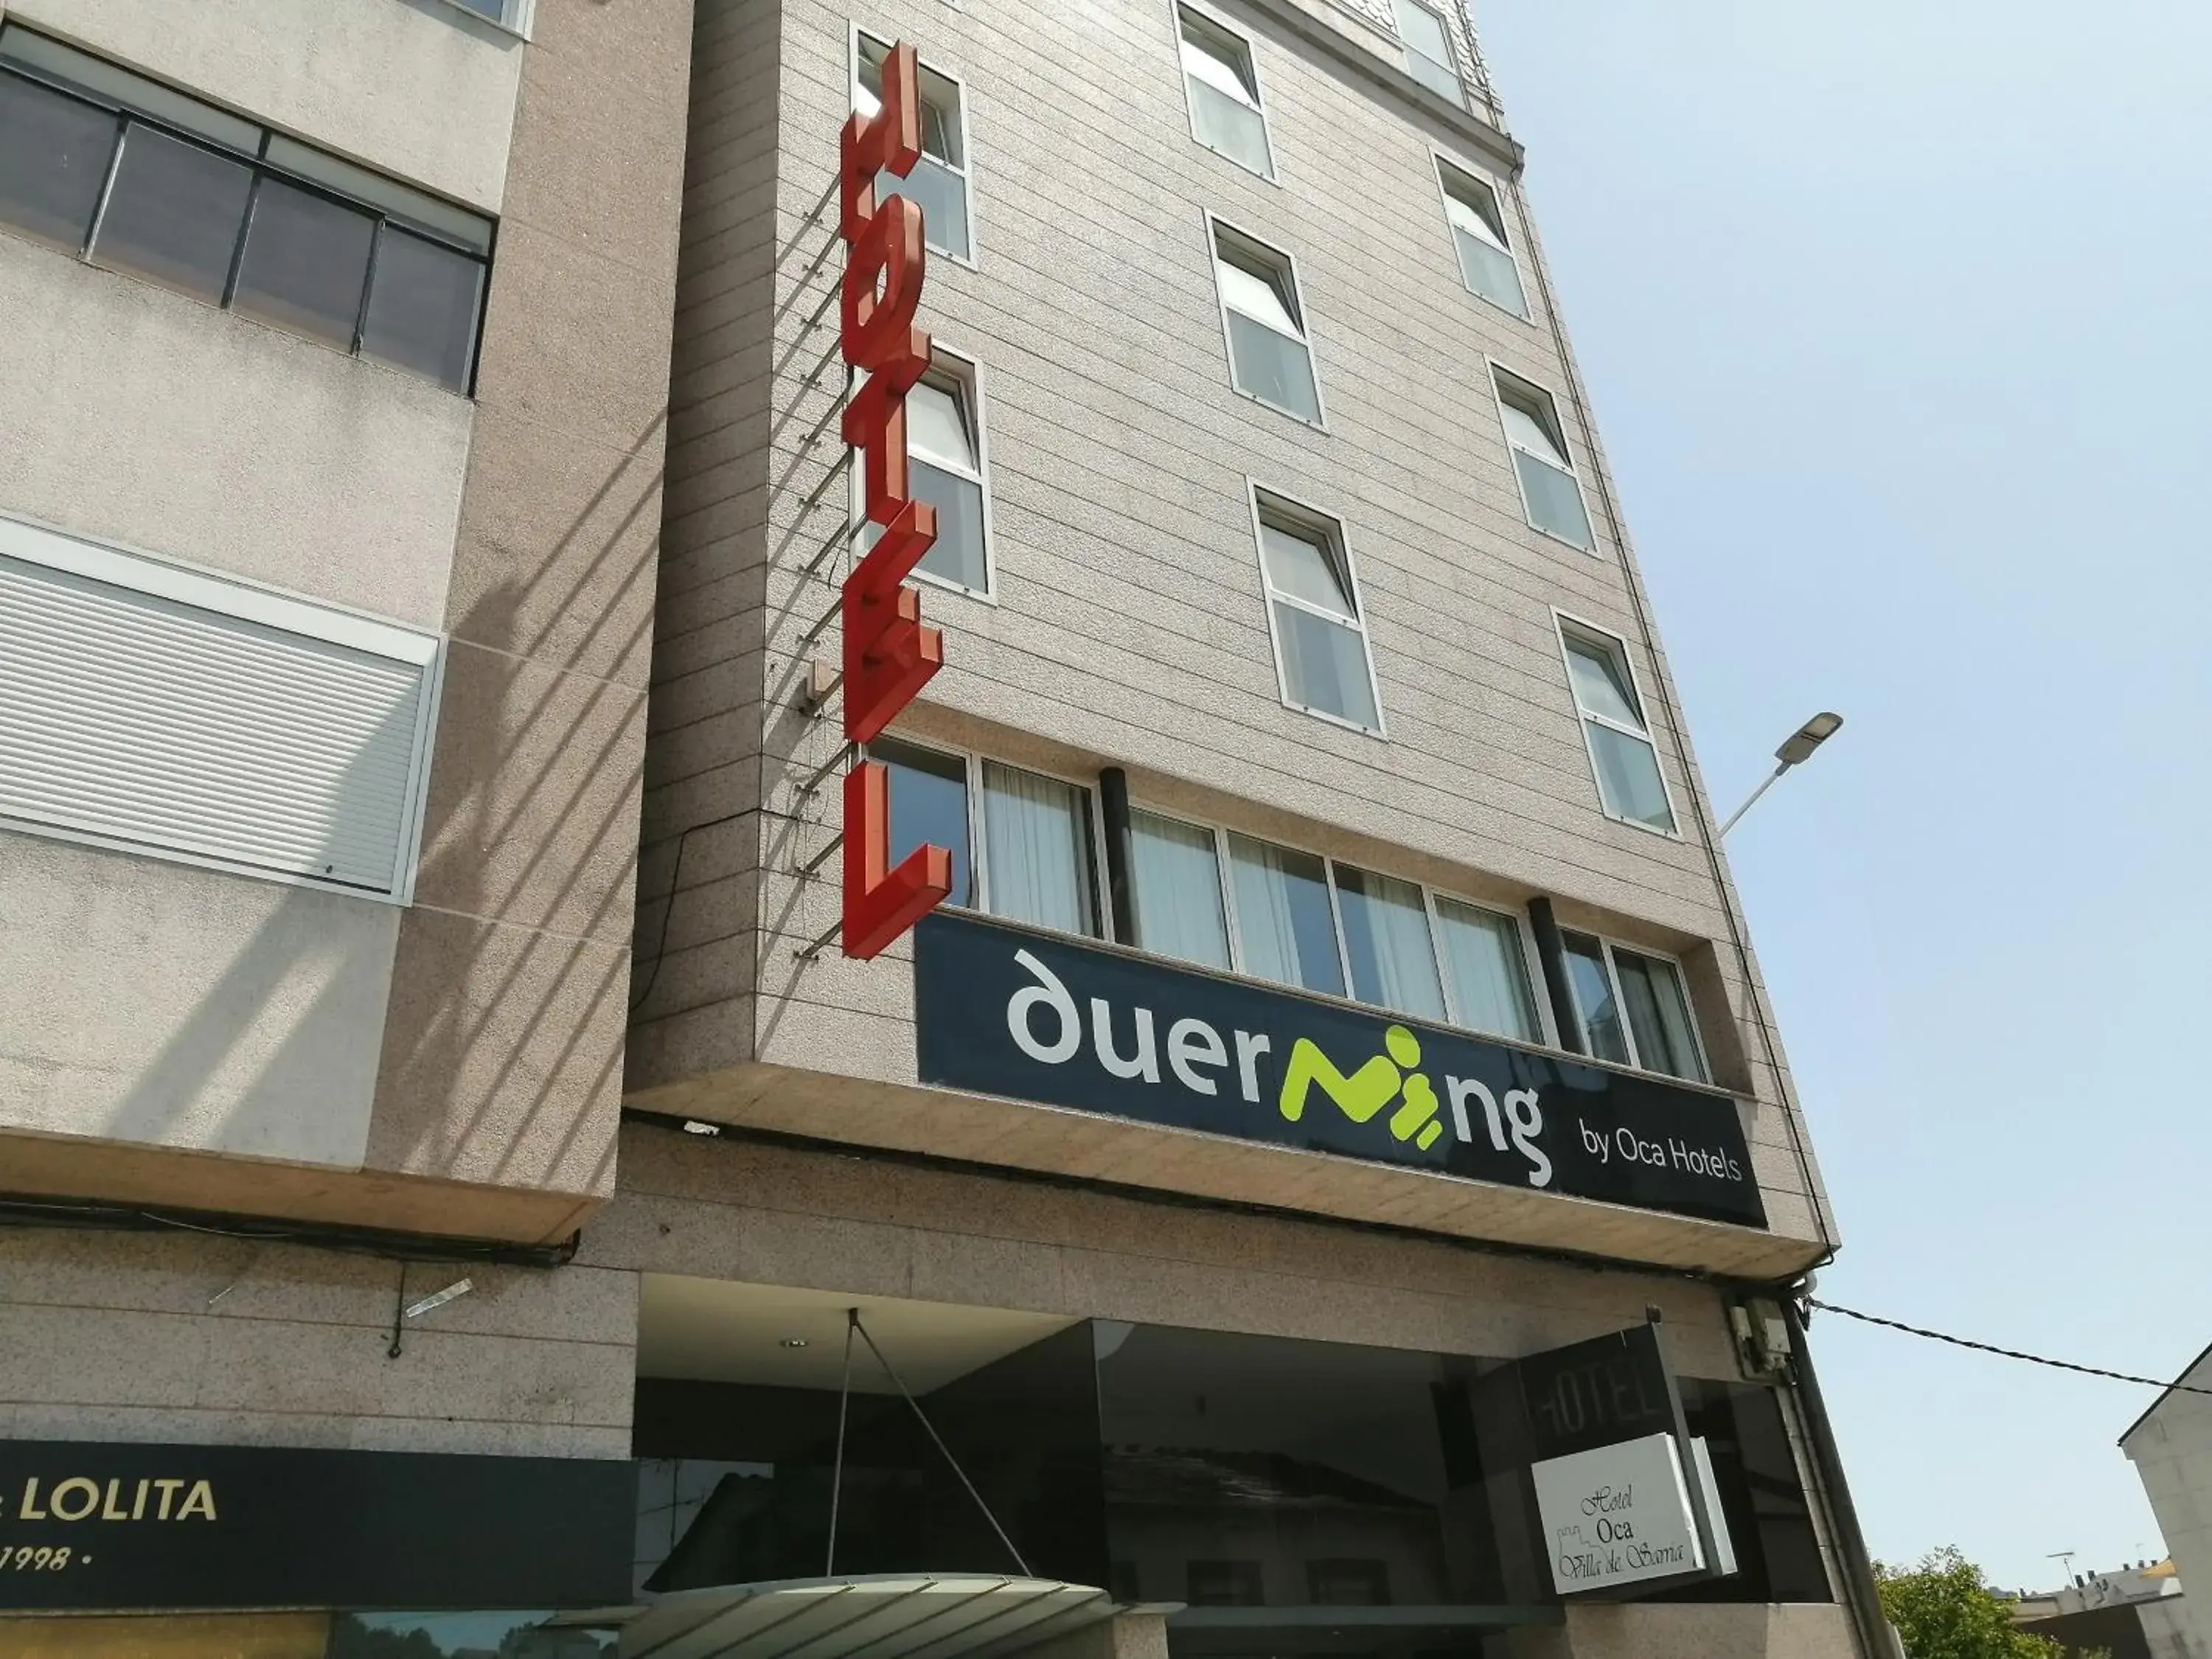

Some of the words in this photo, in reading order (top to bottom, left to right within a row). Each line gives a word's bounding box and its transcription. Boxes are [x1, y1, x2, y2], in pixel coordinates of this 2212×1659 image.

[841, 38, 951, 960] HOTEL
[1579, 1118, 1610, 1164] by
[1615, 1127, 1667, 1167] Oca
[1669, 1138, 1743, 1182] Hotels
[19, 1476, 217, 1521] LOLITA
[1580, 1484, 1633, 1517] Hotel
[1596, 1518, 1635, 1543] Oca
[0, 1546, 72, 1571] 1998
[1559, 1553, 1601, 1579] Villa
[1605, 1549, 1622, 1574] de
